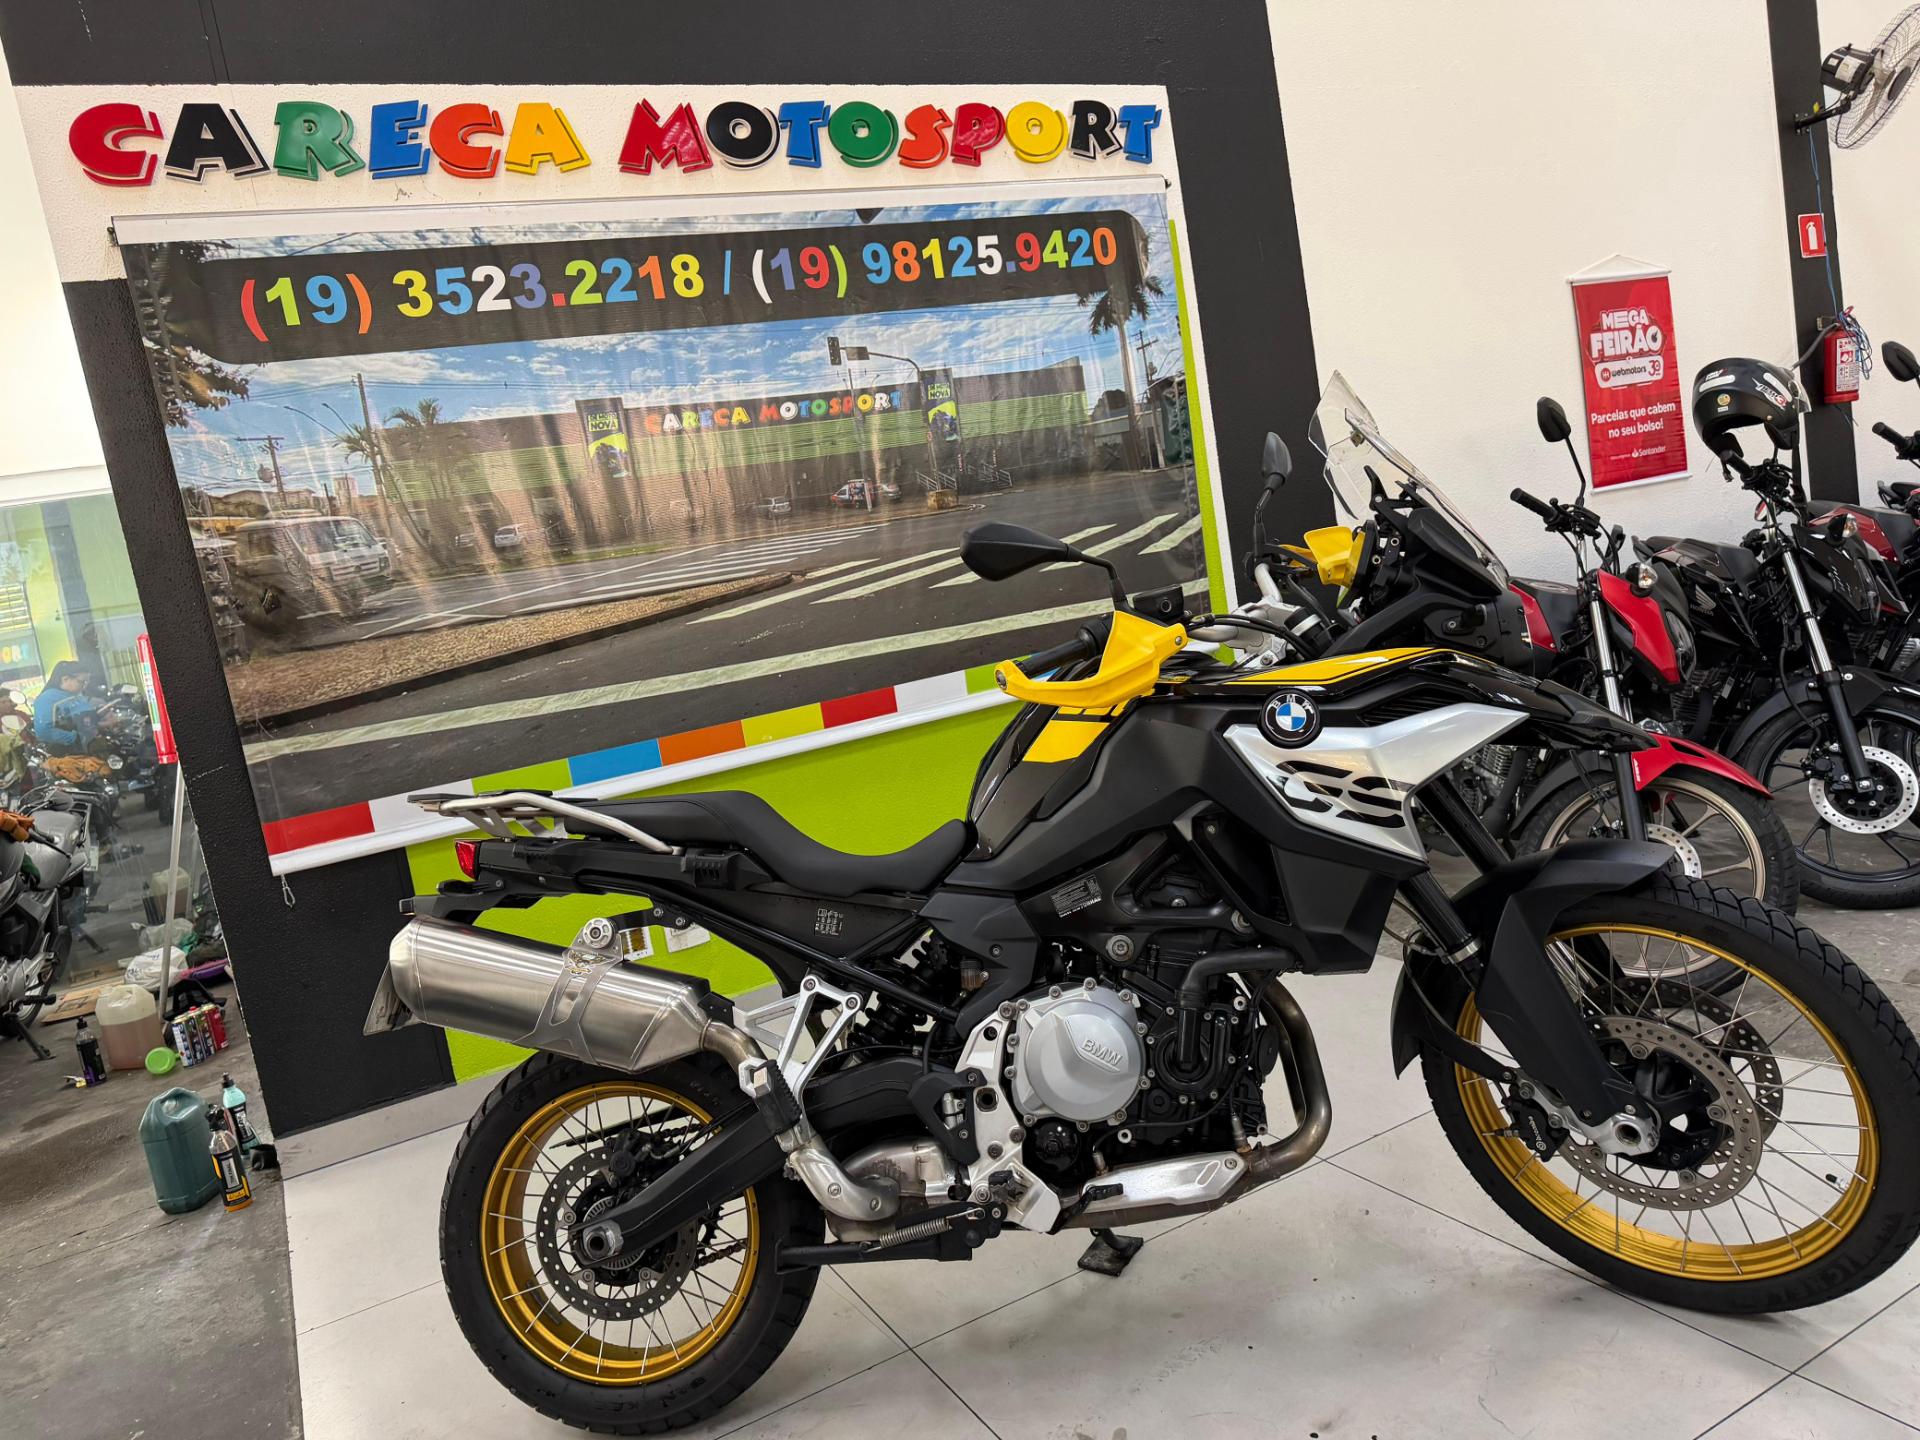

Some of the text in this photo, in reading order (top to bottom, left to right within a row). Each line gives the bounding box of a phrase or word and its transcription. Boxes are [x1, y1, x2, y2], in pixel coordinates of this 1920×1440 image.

[69, 98, 1162, 187] CARECA MOTOSPORT
[240, 273, 372, 342] (19)
[392, 254, 704, 319] 3523.2218
[752, 244, 848, 304] (19)
[862, 226, 1118, 285] 98125.9420
[1602, 308, 1649, 331] MEGA
[1590, 324, 1662, 359] FEIRÃO
[1611, 365, 1647, 377] webmotors
[645, 389, 901, 434] CARECA MOTOSPORT
[1591, 402, 1676, 425] Parcelas que cabem
[1608, 418, 1664, 438] no seu bolso!
[1082, 1039, 1123, 1067] BMW
